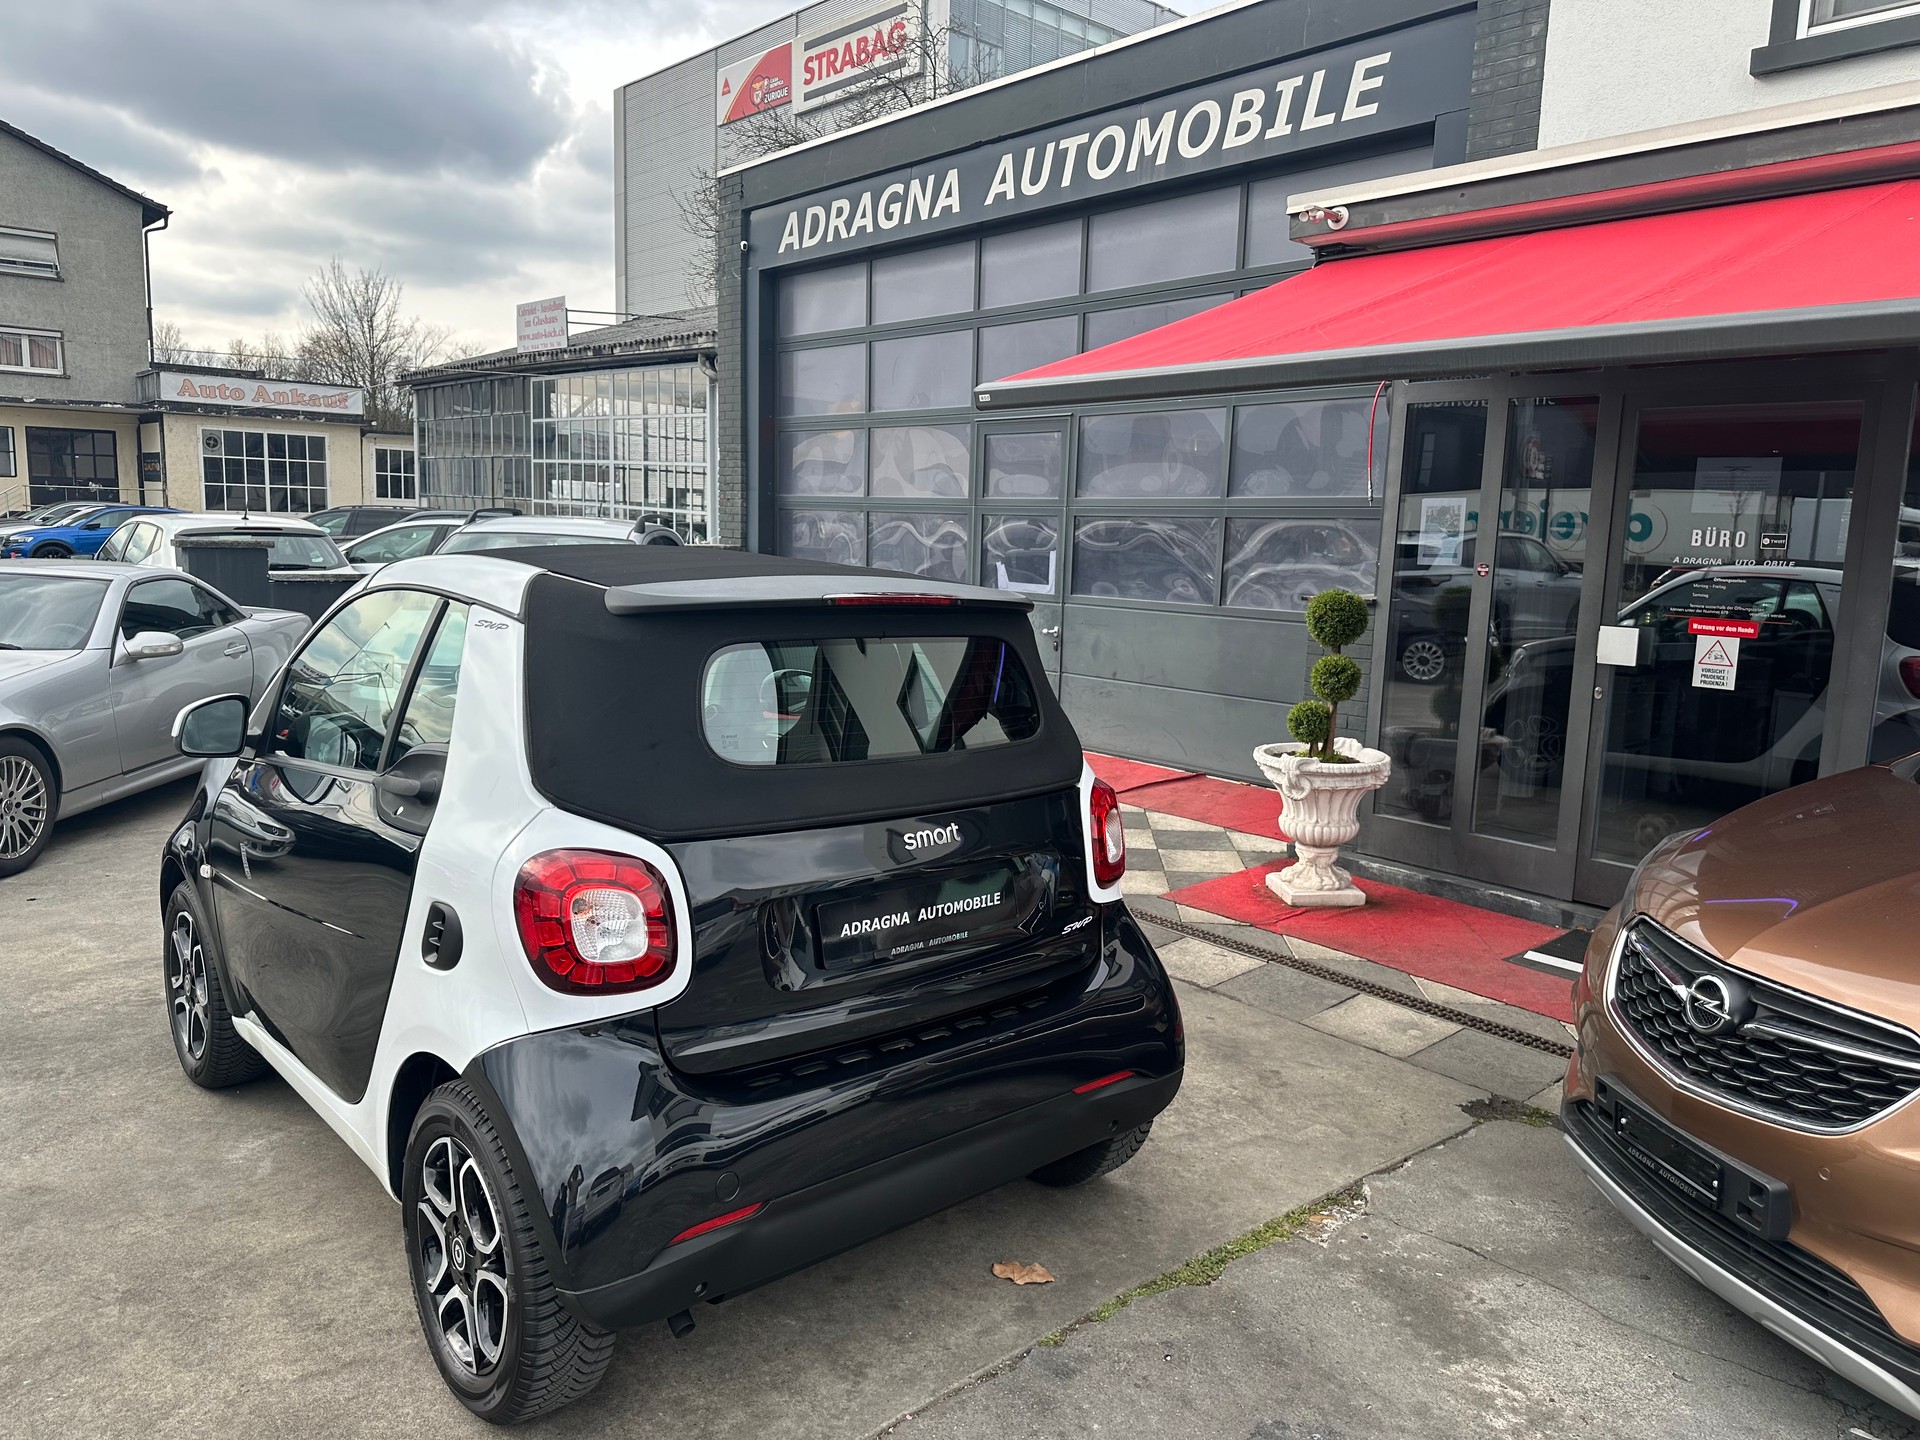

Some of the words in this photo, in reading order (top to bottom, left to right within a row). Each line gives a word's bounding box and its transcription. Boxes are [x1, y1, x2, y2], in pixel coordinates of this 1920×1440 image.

[803, 20, 908, 86] STRABAG
[764, 86, 789, 103] ZURIQUE
[777, 168, 960, 254] ADRAGNA
[984, 52, 1392, 207] AUTOMOBILE
[524, 318, 532, 328] im
[533, 315, 558, 326] Glashaus
[176, 378, 246, 401] Auto
[252, 385, 350, 409] Ankauf
[1690, 527, 1746, 548] BÜRO
[1692, 622, 1715, 632] Warnung
[1737, 626, 1755, 634] Hunde
[1699, 680, 1725, 688] PRUDENZA
[1700, 673, 1725, 681] PRUDENCE
[903, 822, 962, 850] smart
[840, 911, 911, 938] ADRAGNA
[918, 892, 1001, 922] AUTOMOBILE
[891, 941, 924, 956] ADRAGNA
[928, 931, 969, 947] AUTOMOBILE
[1627, 1146, 1656, 1169] ADRAGNA
[1658, 1168, 1697, 1198] AUTOMOBILE
